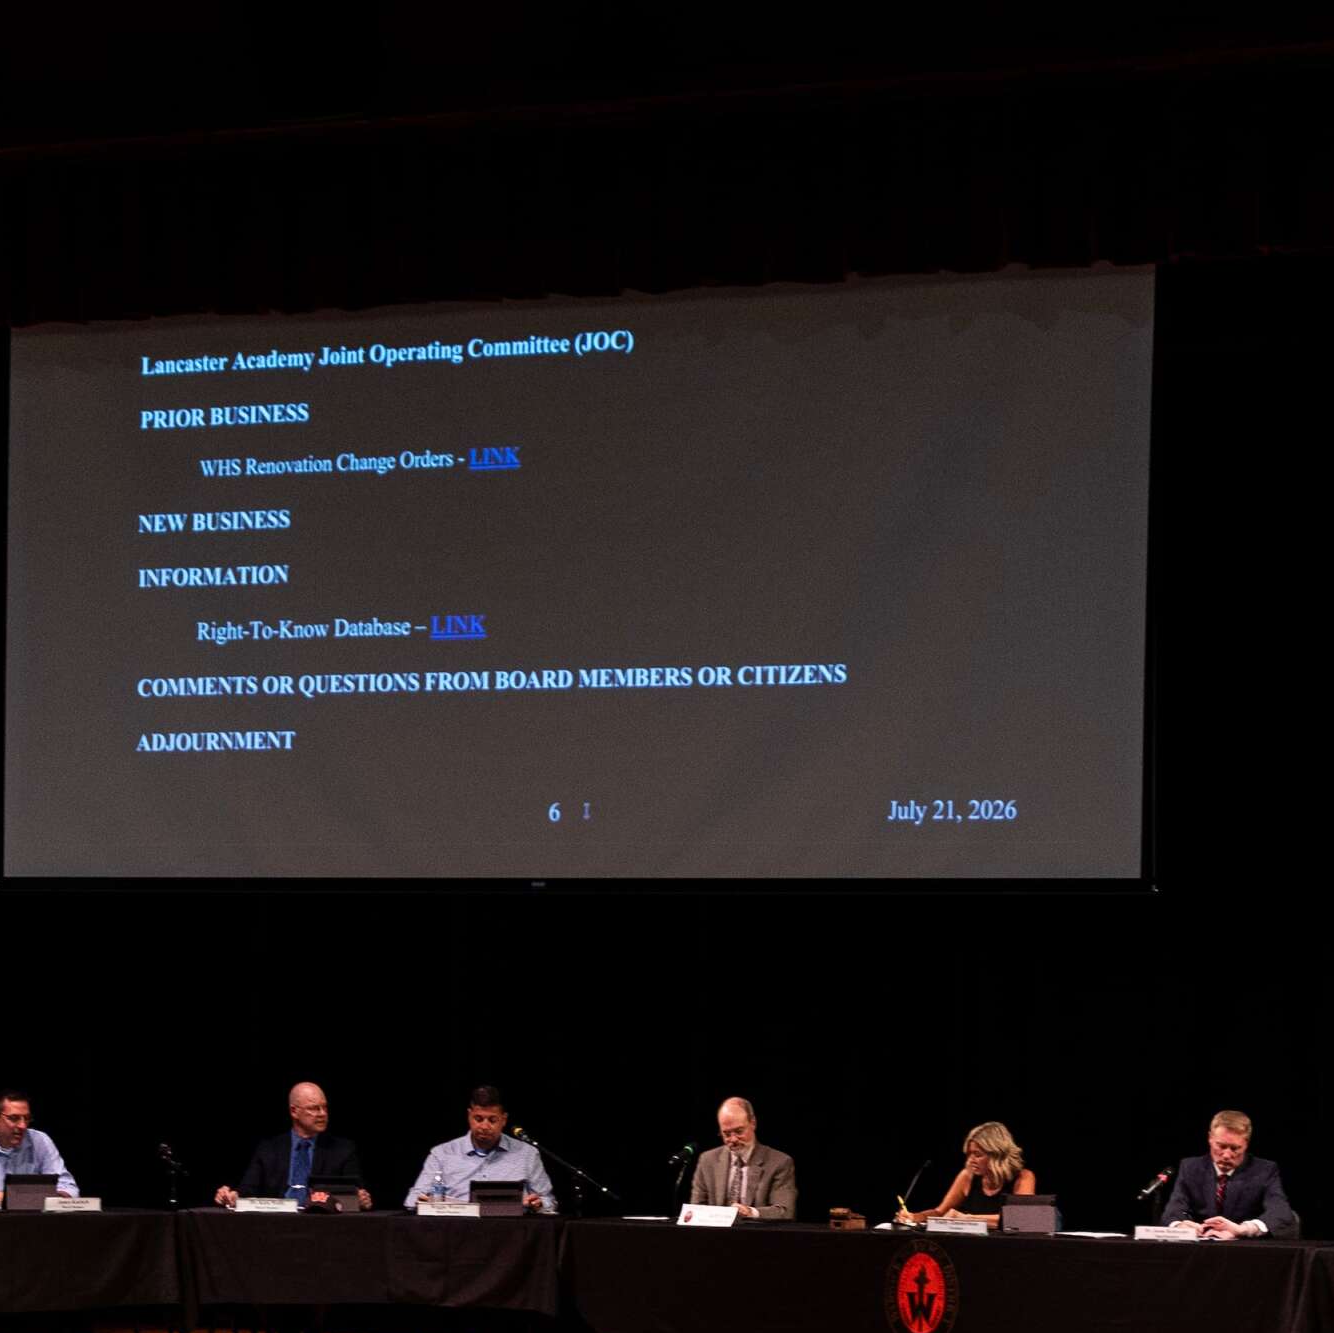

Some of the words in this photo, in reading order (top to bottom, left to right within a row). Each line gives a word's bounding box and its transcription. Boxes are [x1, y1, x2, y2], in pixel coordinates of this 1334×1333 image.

[140, 354, 230, 377] Lancaster
[230, 349, 316, 373] Academy
[317, 345, 367, 368] Joint
[367, 340, 464, 369] Operating
[466, 335, 572, 359] Committee
[573, 329, 635, 357] (JOC)
[139, 407, 207, 431] PRIOR
[208, 402, 310, 427] BUSINESS
[199, 457, 243, 478] WHS
[244, 454, 334, 477] Renovation
[334, 452, 397, 476] Change
[397, 449, 455, 470] Orders
[468, 446, 522, 472] LINK
[137, 512, 188, 534] NEW
[191, 508, 292, 533] BUSINESS
[138, 563, 290, 589] INFORMATION
[195, 619, 331, 646] Right-To-Know
[333, 616, 412, 639] Database
[429, 613, 489, 641] LINK
[136, 674, 260, 699] COMMENTS
[259, 675, 296, 696] OR
[297, 671, 422, 699] QUESTIONS
[422, 670, 491, 693] FROM
[493, 668, 575, 693] BOARD
[577, 666, 694, 689] MEMBERS
[694, 665, 734, 689] OR
[736, 663, 848, 688] CITIZENS
[134, 730, 298, 753] ADJOURNMENT
[547, 801, 562, 824] 6
[886, 799, 929, 827] July
[931, 799, 964, 824] 21,
[966, 799, 1020, 822] 2026
